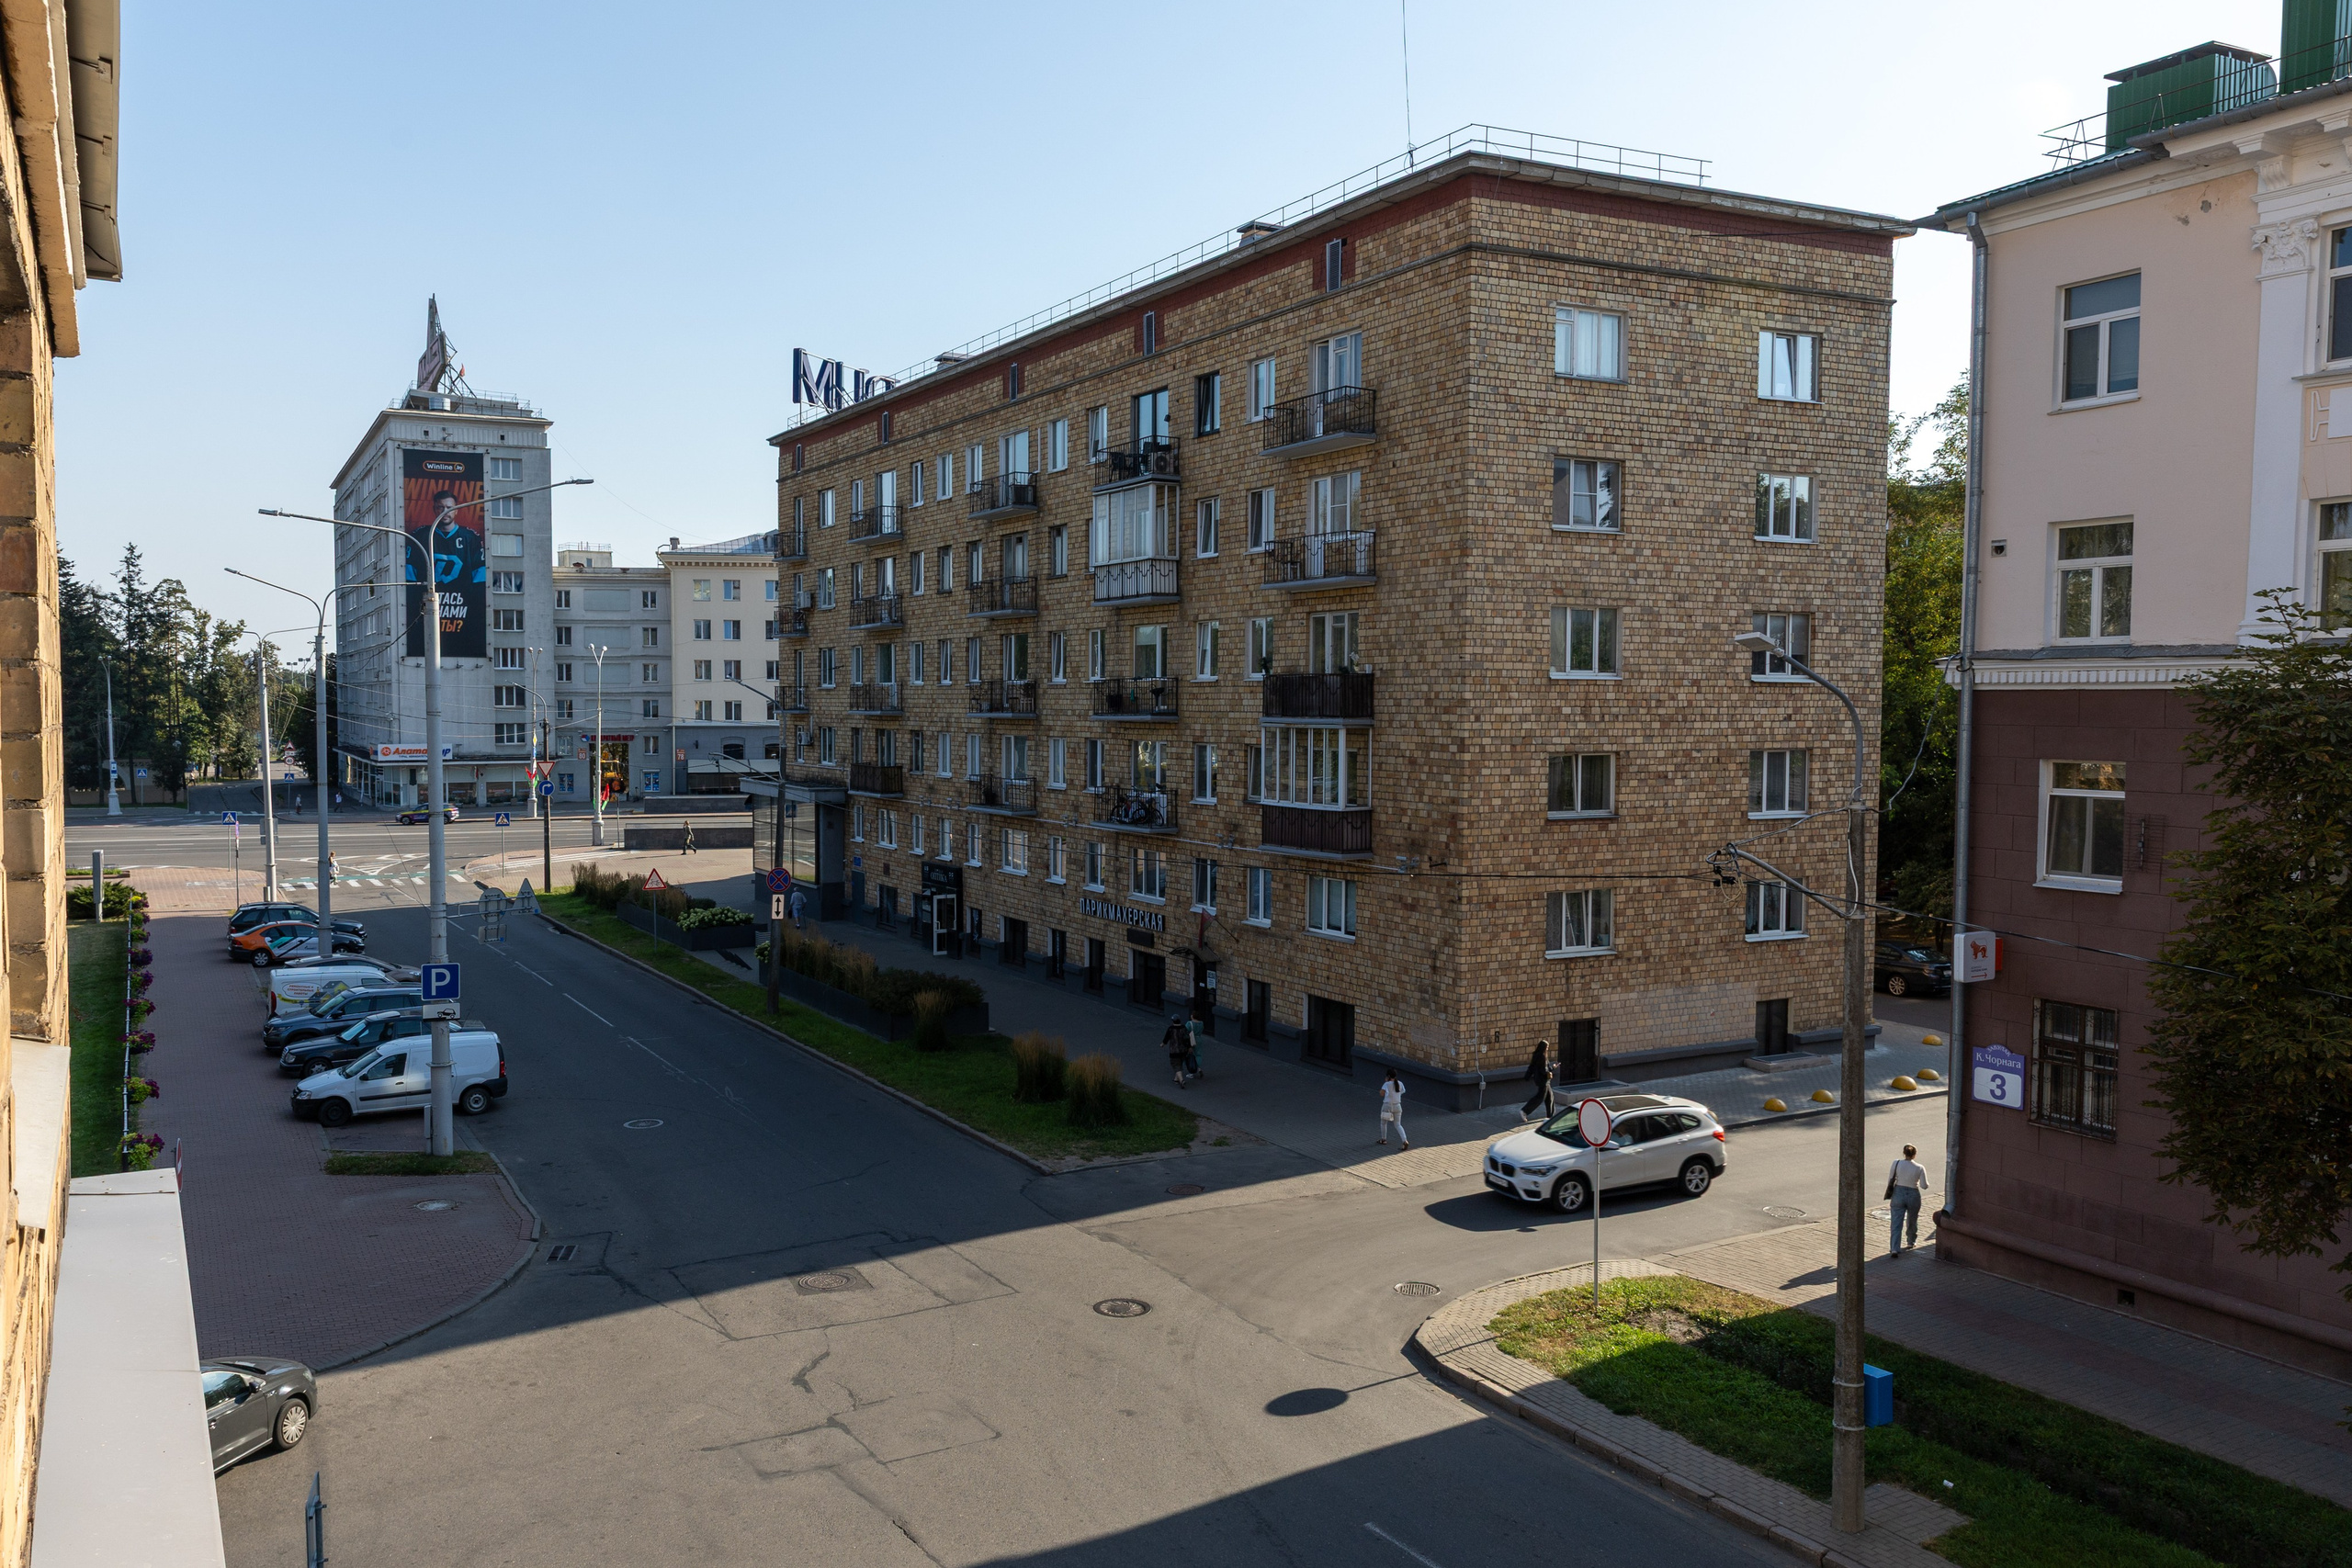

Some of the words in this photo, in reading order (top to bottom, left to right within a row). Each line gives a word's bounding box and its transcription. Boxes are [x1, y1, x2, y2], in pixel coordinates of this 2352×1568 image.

[441, 619, 464, 633] ТЫ?
[393, 747, 427, 755] Алата
[1080, 898, 1163, 932] ПАРИКМАХЕРСКАЯ
[431, 968, 450, 996] P
[1976, 1052, 1984, 1062] К.
[1984, 1054, 2021, 1068] Чорнага
[1990, 1074, 2007, 1100] 3
